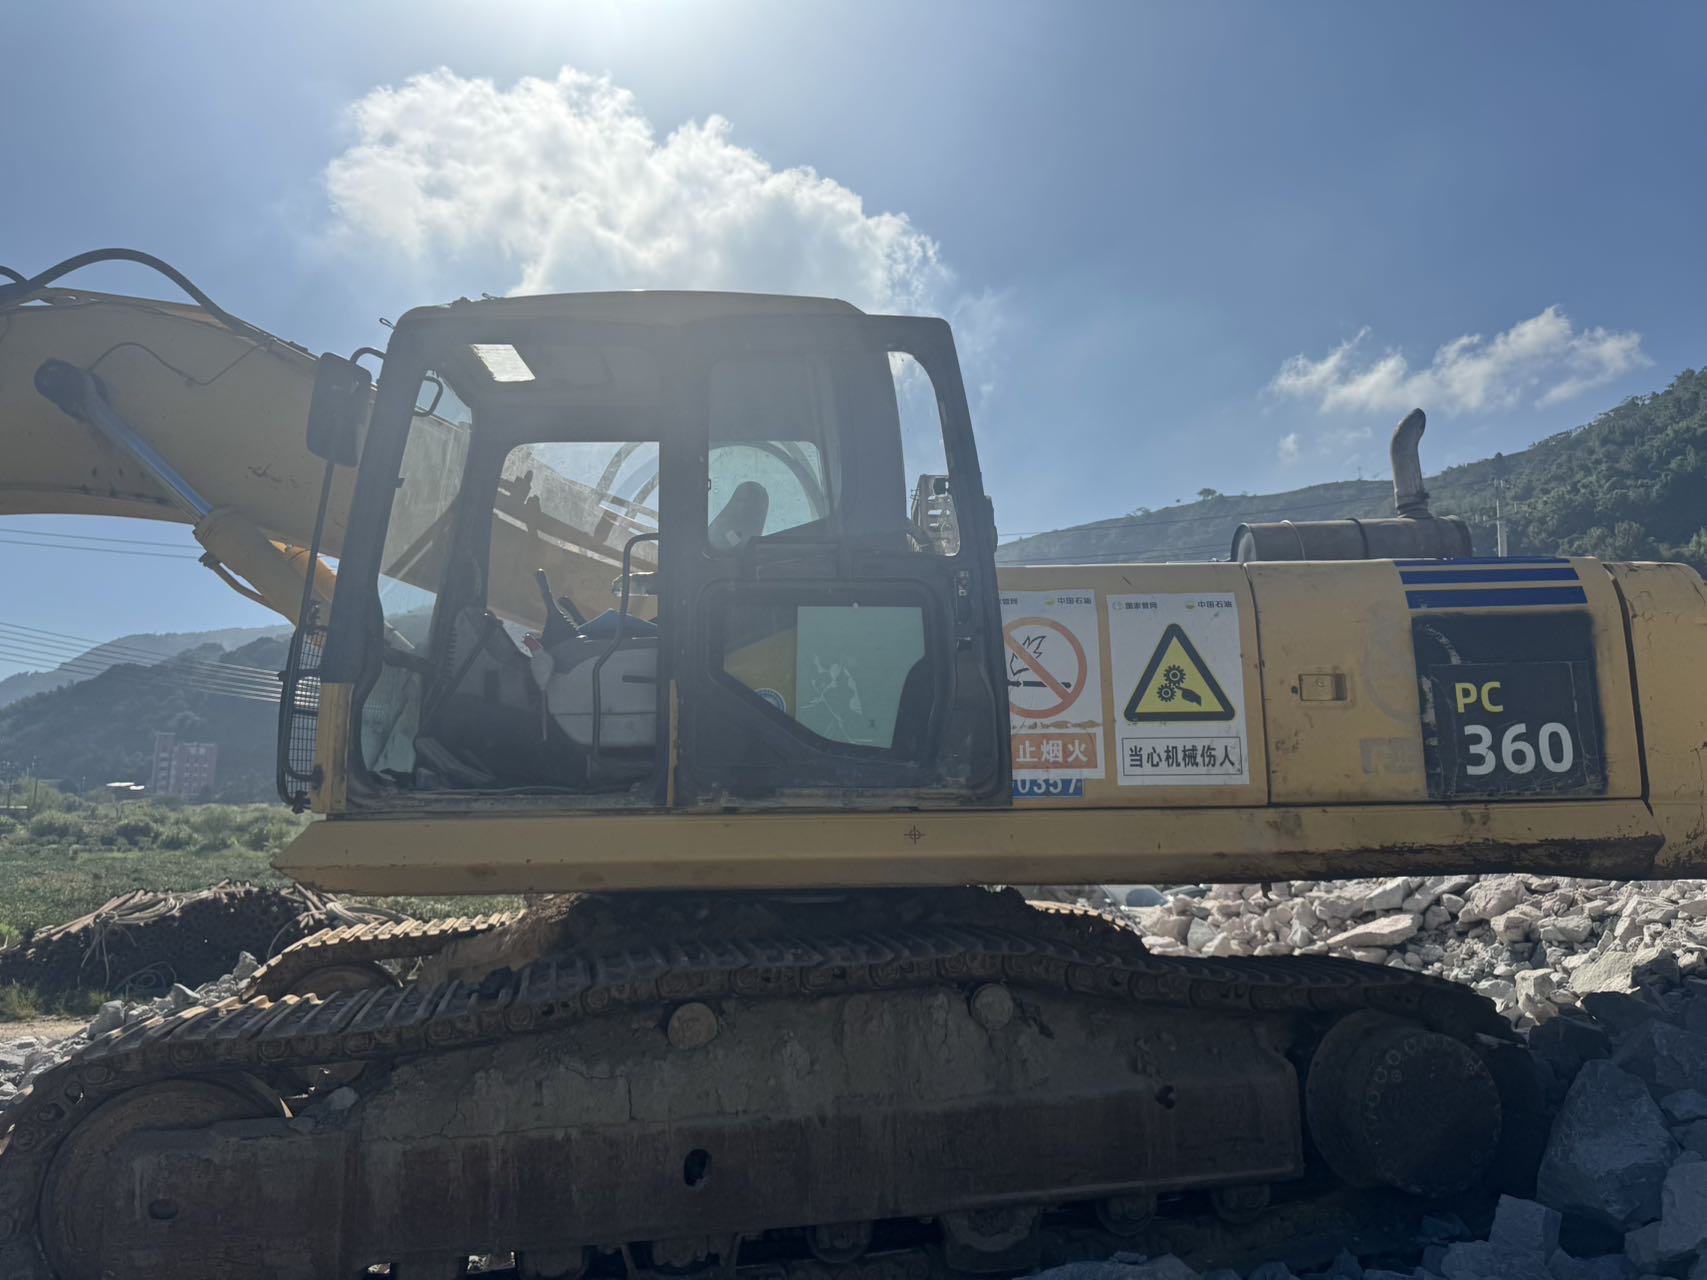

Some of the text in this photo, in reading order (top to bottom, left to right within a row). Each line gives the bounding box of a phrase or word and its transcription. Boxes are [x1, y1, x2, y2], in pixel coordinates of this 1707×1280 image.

[1197, 600, 1232, 608] 中国石油
[1455, 681, 1504, 713] PC
[1016, 739, 1088, 763] 止烟火
[1129, 744, 1235, 768] 当心机械伤人
[1463, 722, 1574, 776] 360
[1012, 778, 1077, 794] 0357
